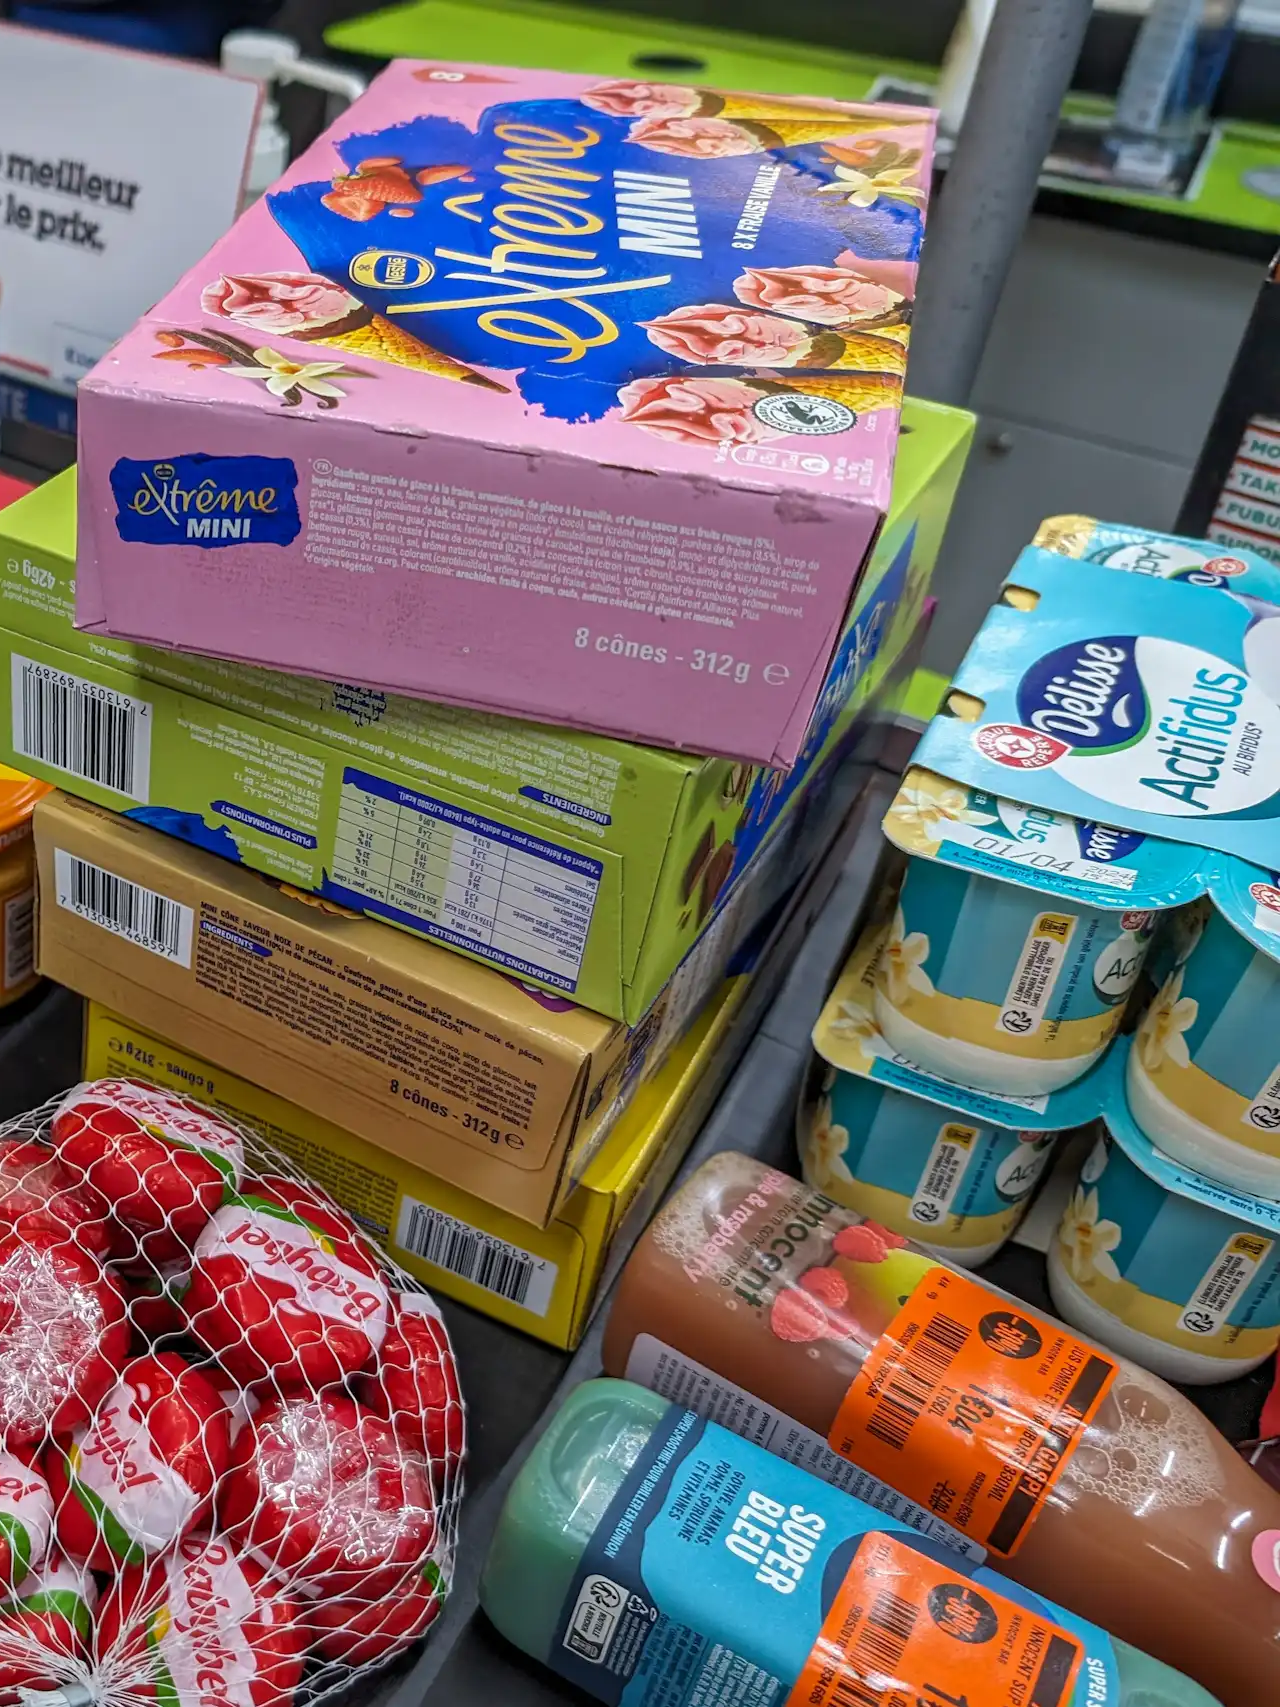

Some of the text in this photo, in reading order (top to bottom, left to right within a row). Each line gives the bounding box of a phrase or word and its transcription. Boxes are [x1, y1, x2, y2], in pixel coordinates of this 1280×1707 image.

[2, 144, 142, 209] meilleur
[748, 160, 781, 204] VANILLE
[31, 201, 112, 256] prix.
[613, 170, 703, 259] MINI
[736, 195, 769, 235] FRAISE
[1250, 438, 1280, 462] MO
[1238, 471, 1280, 496] TAK
[186, 517, 251, 539] MINI
[1225, 502, 1280, 530] FUBU
[22, 559, 57, 590] 426g
[575, 627, 588, 649] 8
[595, 633, 668, 665] cônes
[26, 662, 131, 708] 613035 892897
[1030, 642, 1128, 739] Délisse
[1138, 668, 1249, 811] Actifidus
[1232, 758, 1252, 777] AU
[220, 805, 312, 848] PLUS D'INFORMATIONS?
[540, 791, 608, 824] INGREDIENTS
[970, 833, 1076, 875] 01/04
[584, 879, 596, 890] Sel
[571, 899, 591, 913] Fibres
[74, 904, 174, 957] 613035 468597
[199, 900, 218, 914] MINI
[219, 908, 241, 923] CÔNE
[241, 919, 272, 938] SAVEUR
[272, 933, 292, 947] NOIX
[306, 946, 334, 965] PÉCAN
[201, 920, 254, 951] INGREDIENTS
[425, 924, 573, 990] DÉCLARATIONS NUTRITIONNELLES
[84, 1078, 238, 1150] Babybel
[389, 1078, 399, 1095] 8
[403, 1087, 449, 1119] cônes
[681, 1198, 754, 1284] raspberry
[225, 1220, 383, 1322] Babybel
[1065, 1344, 1086, 1365] JUS
[1048, 1360, 1077, 1395] POMME
[656, 1426, 685, 1465] SMOOTHIE
[645, 1458, 666, 1482] POUR
[666, 1459, 710, 1523] ET VITAMINES
[985, 1463, 1017, 1504] 330ML
[622, 1506, 637, 1520] EN
[628, 1478, 653, 1511] BRILLER
[675, 1457, 732, 1543] POMME, SPIRULINE
[693, 1468, 746, 1549] GOYAVE, ANANAS,
[602, 1517, 633, 1559] RÉUNION
[723, 1490, 787, 1566] BLEU
[754, 1503, 828, 1595] SUPER
[1009, 1623, 1052, 1681] INNOCENT
